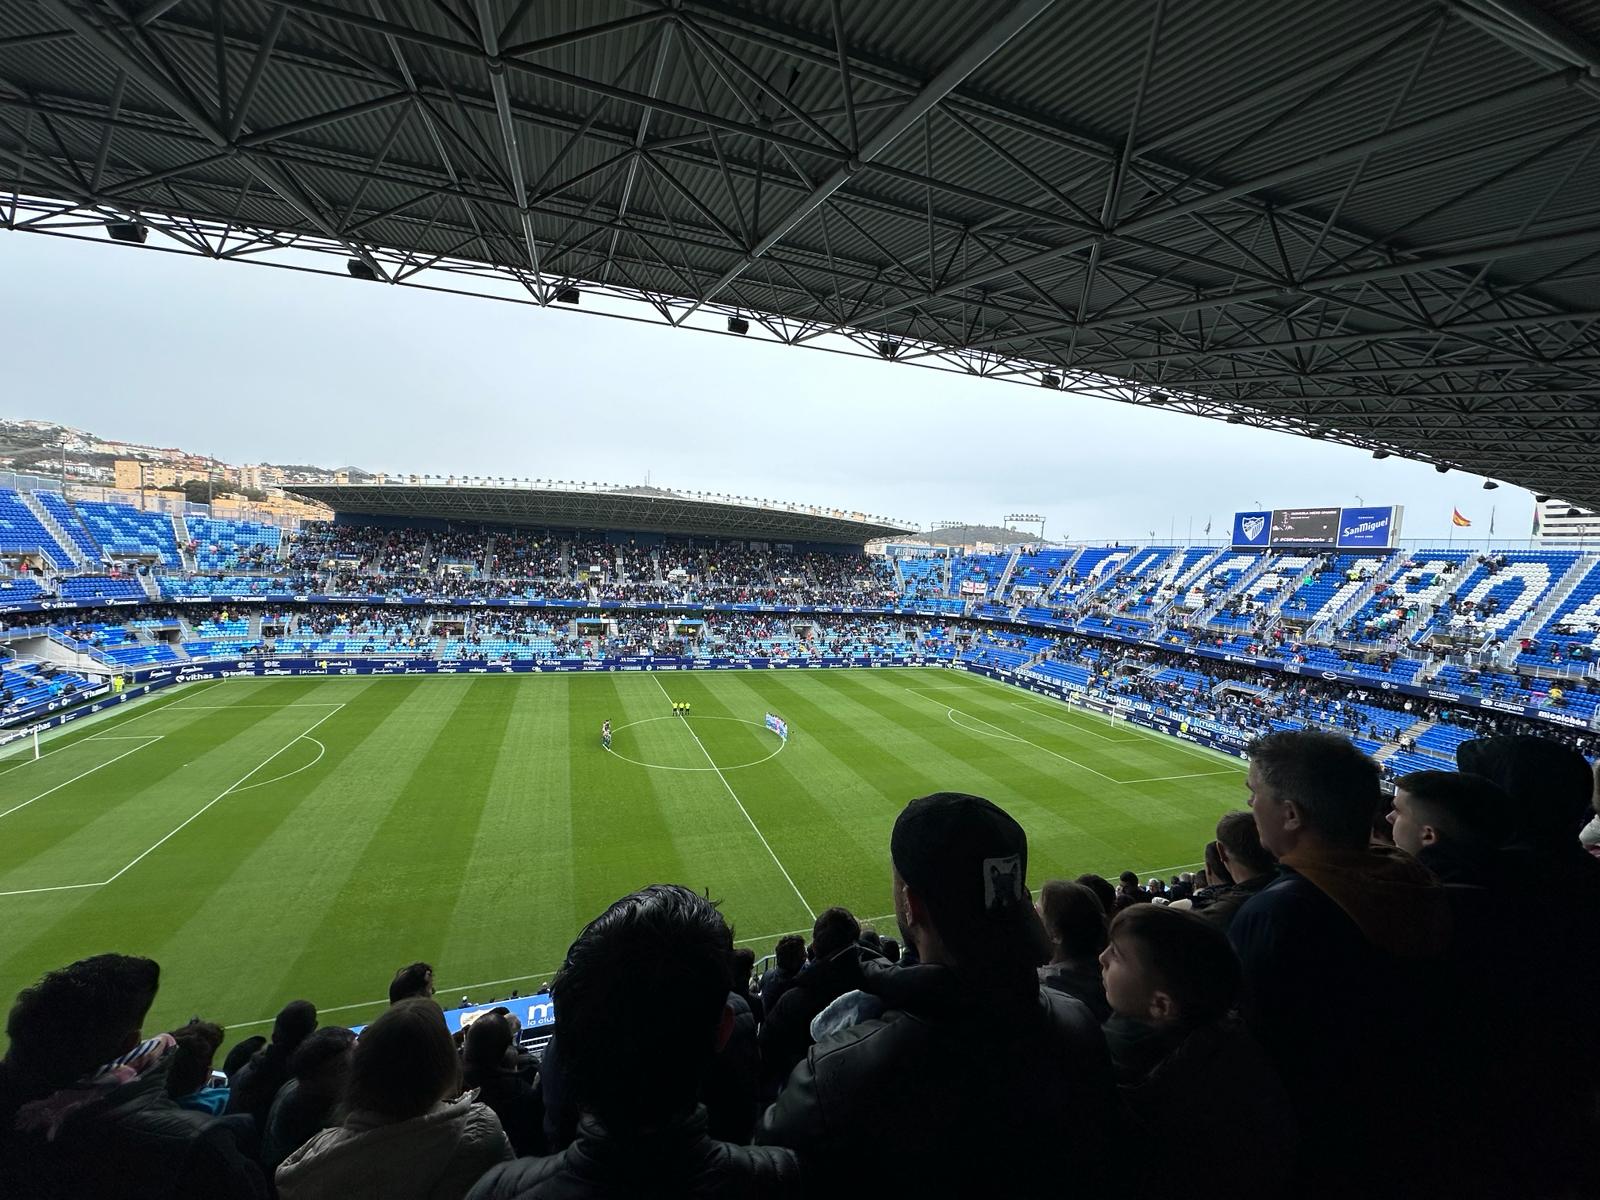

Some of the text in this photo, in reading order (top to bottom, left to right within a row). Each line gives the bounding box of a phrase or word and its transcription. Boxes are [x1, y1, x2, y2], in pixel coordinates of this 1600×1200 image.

[52, 601, 78, 609] vithas
[185, 673, 214, 681] vithas
[1044, 675, 1052, 683] DE
[1052, 677, 1061, 686] UN
[1062, 680, 1086, 693] ESCUDO
[1134, 701, 1152, 712] SUR
[1494, 701, 1525, 712] campano
[1170, 711, 1191, 724] 1904
[1190, 726, 1212, 738] vithas
[1199, 720, 1239, 737] MALAKA
[527, 1018, 536, 1026] la
